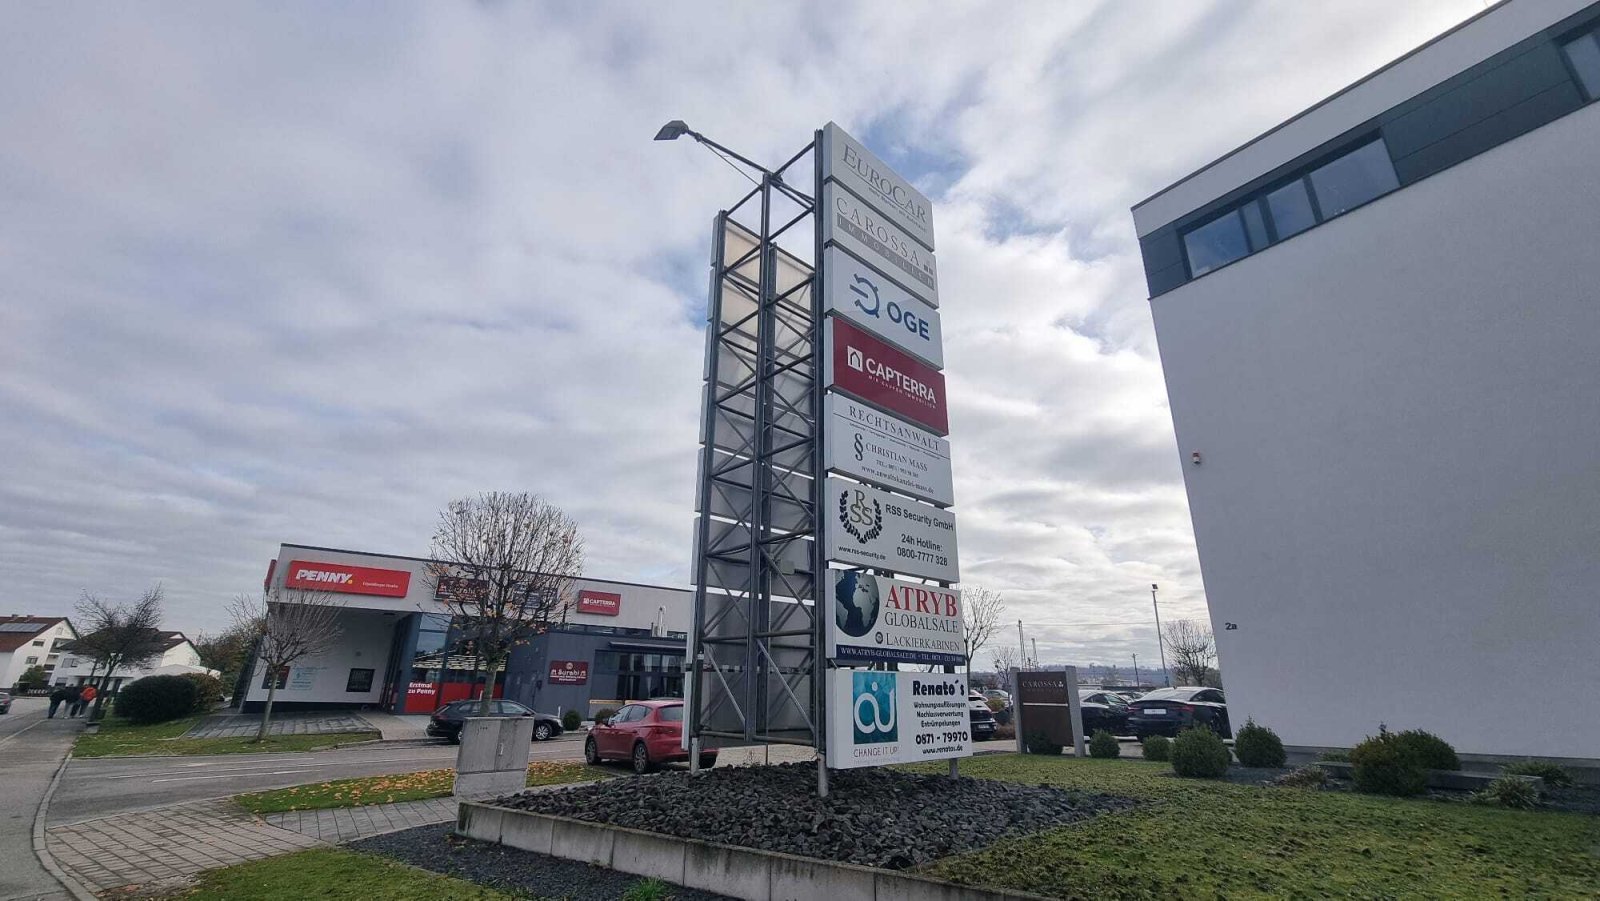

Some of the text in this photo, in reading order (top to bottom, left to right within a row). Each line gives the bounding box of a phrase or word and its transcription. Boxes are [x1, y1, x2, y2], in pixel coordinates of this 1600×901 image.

[841, 144, 926, 223] EUROCAR
[836, 197, 920, 266] CAROSSA
[887, 301, 930, 341] OGE
[866, 358, 936, 403] CAPTERRA
[849, 405, 940, 451] RECHTSANWALT
[865, 442, 928, 472] CHRISTIAN MASS
[885, 503, 954, 531] RSS Security GmbH
[896, 546, 948, 566] 0800-7777 328
[901, 533, 943, 552] 24h Hotline:
[885, 584, 958, 617] ATRYB
[884, 611, 960, 634] GLOBALSALE
[1224, 622, 1238, 630] 2a
[886, 632, 960, 652] LACKIERKABINEN
[853, 747, 881, 758] CHANGE
[882, 746, 888, 755] IT
[915, 732, 934, 745] 0871
[942, 731, 968, 743] 79970
